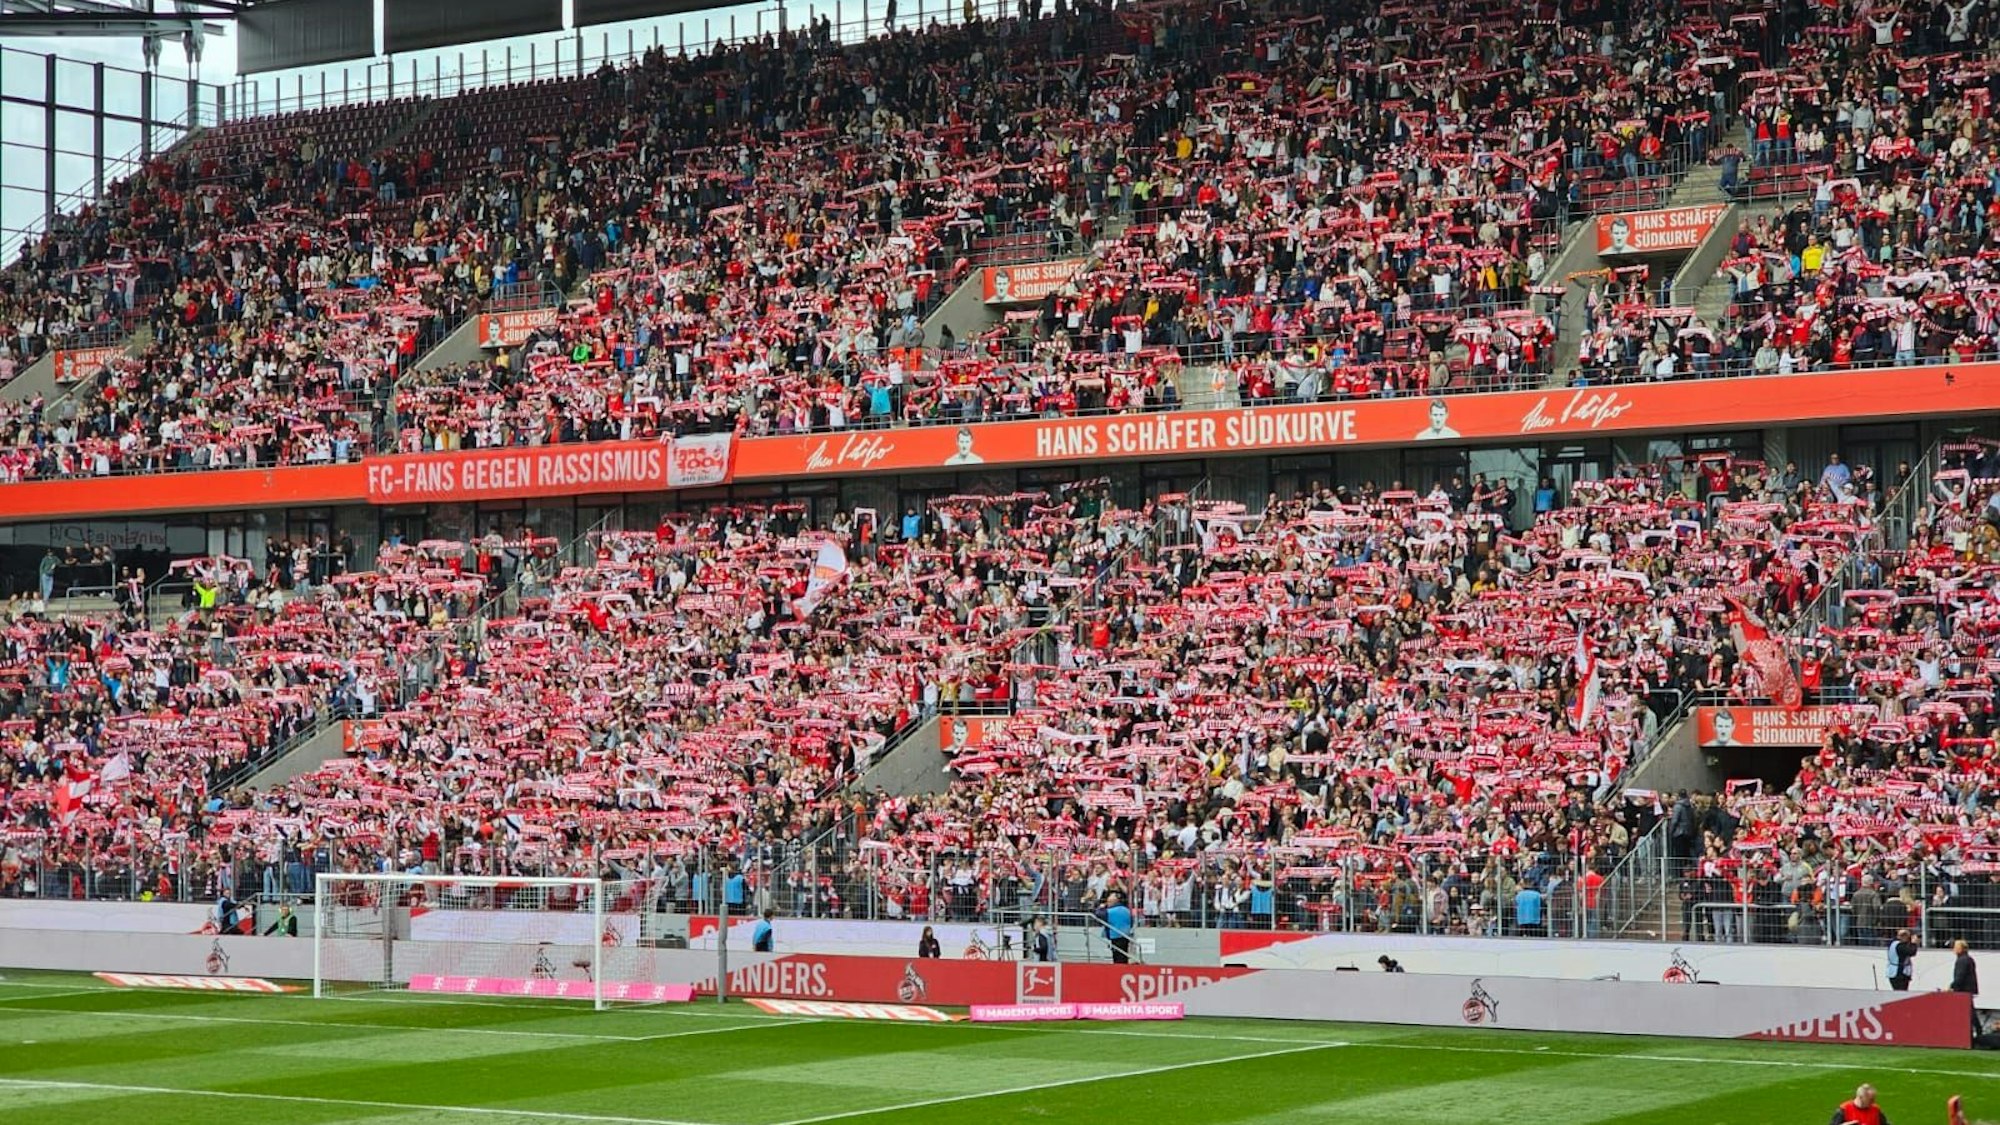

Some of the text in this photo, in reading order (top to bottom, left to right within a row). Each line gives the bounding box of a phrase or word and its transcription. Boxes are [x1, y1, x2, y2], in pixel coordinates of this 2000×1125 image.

[1634, 214, 1666, 230] HANS
[1634, 229, 1698, 248] SÜDKURVE
[1014, 267, 1040, 281] HANS
[1036, 410, 1357, 456] HANS SCHÄFER SÜDKURVE
[368, 449, 661, 494] FC-FANS GEGEN RASSISMUS
[1752, 710, 1787, 726] HANS
[1752, 727, 1822, 744] SÜDKURVE
[1038, 1006, 1073, 1016] SPORT
[1092, 1005, 1145, 1015] MAGENTA
[1144, 1005, 1179, 1015] SPORT
